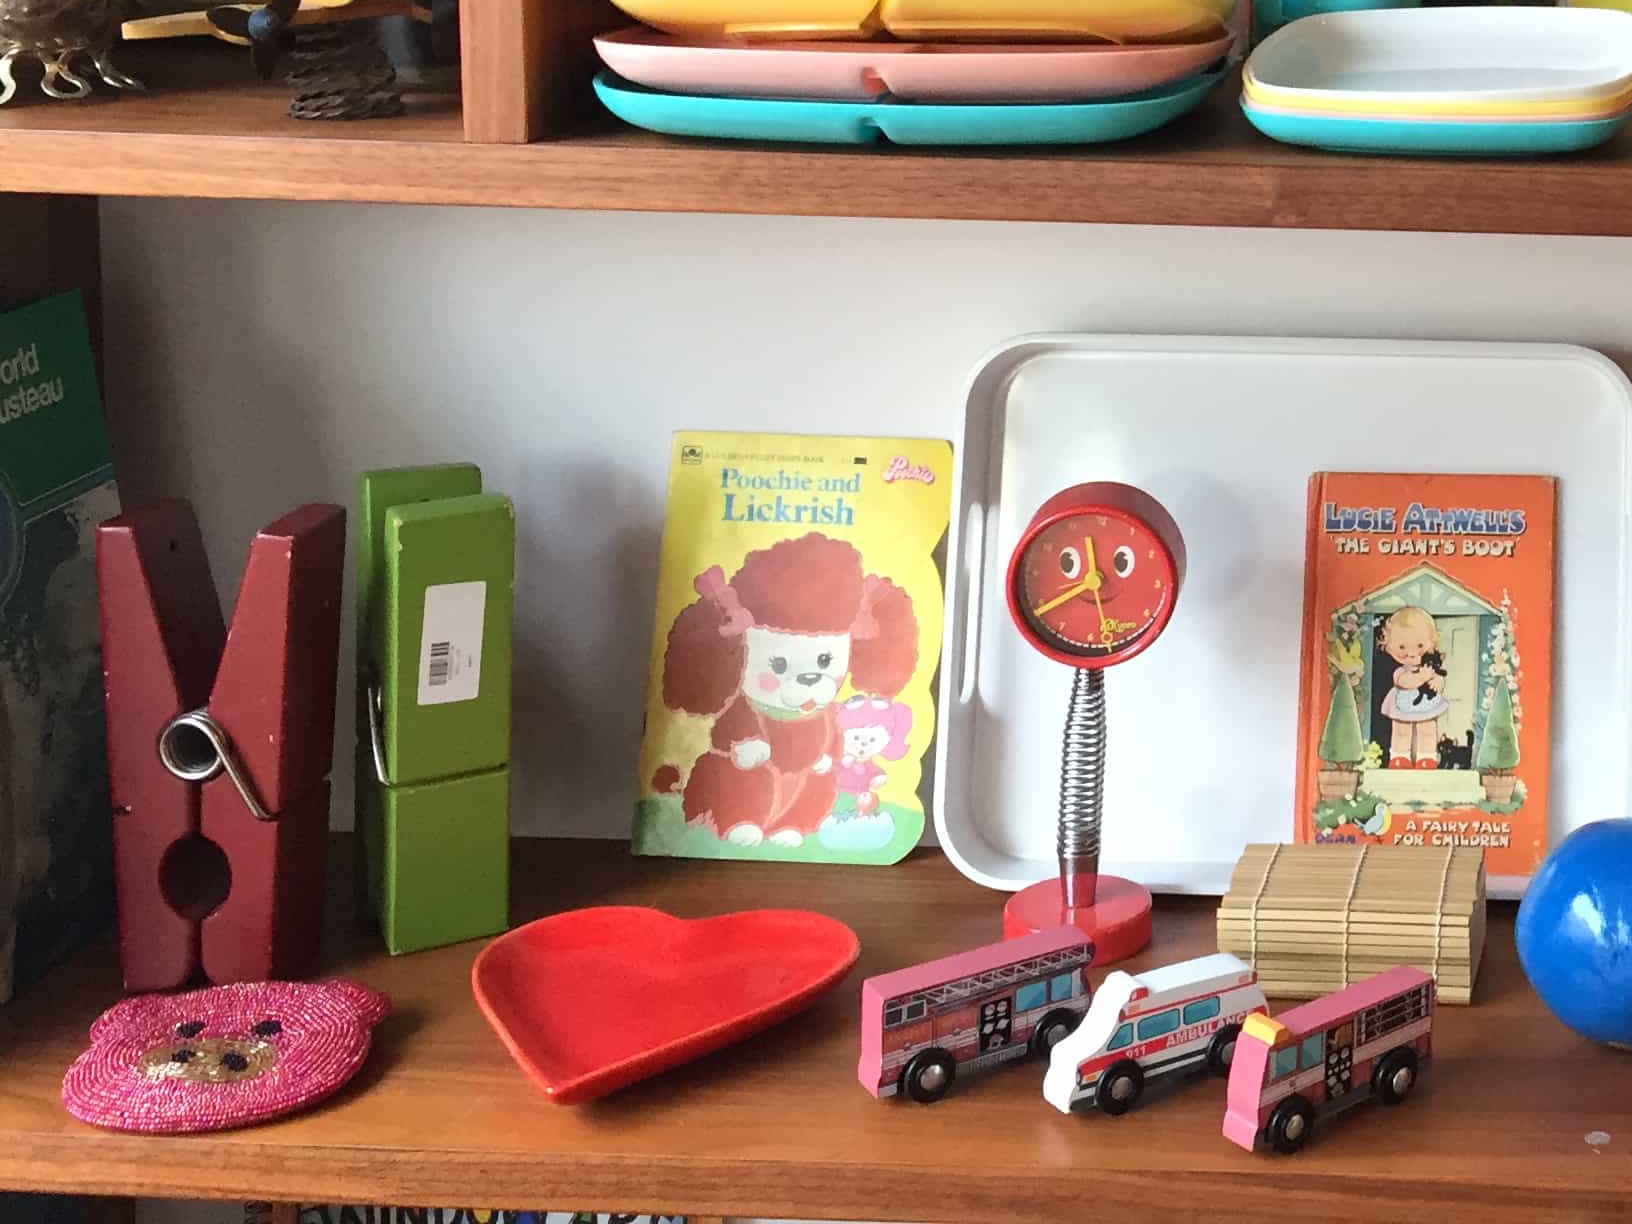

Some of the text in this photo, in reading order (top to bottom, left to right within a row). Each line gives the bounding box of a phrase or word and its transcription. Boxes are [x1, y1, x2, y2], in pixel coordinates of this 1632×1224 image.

[720, 467, 861, 493] Poochie and
[721, 493, 855, 526] Lickrish
[1323, 502, 1396, 534] LUCIE
[1377, 538, 1456, 556] GIANT'S
[1406, 820, 1511, 833] A FAIRY TALE
[1393, 833, 1510, 848] FOR CHILDREN
[1125, 1044, 1148, 1059] 911
